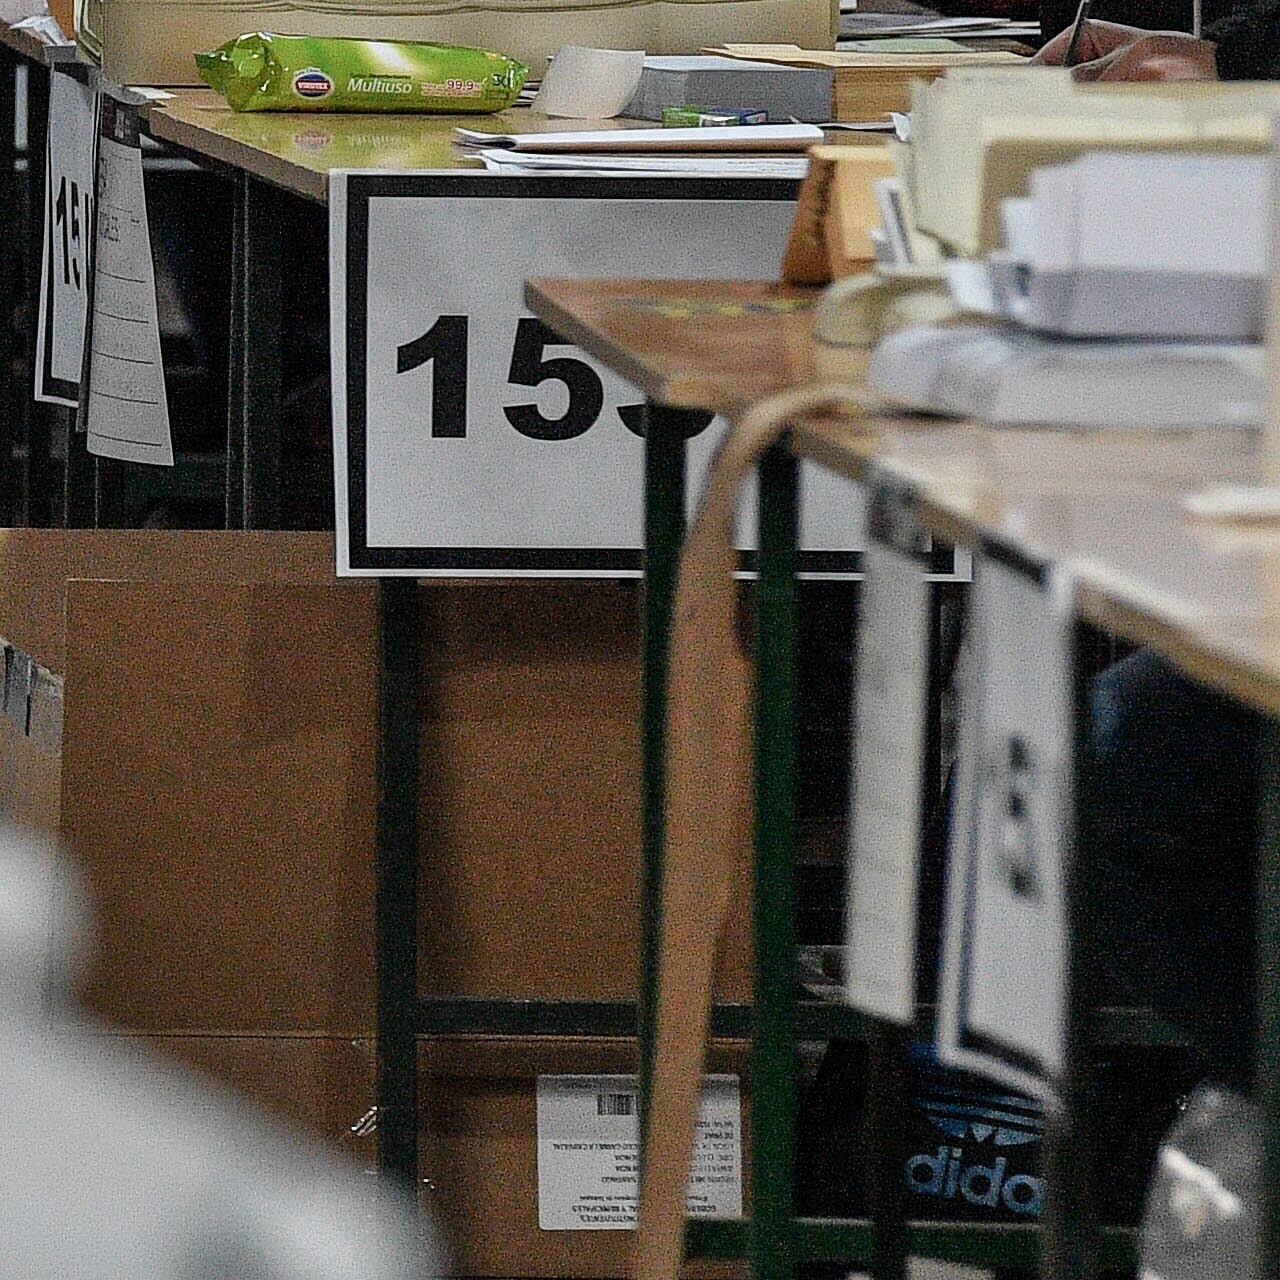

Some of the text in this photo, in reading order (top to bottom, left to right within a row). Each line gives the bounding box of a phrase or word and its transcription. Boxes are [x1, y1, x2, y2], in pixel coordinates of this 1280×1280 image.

[347, 78, 413, 94] Multiuso
[56, 175, 93, 290] 15
[396, 314, 716, 441] 15
[906, 1145, 1048, 1216] dida
